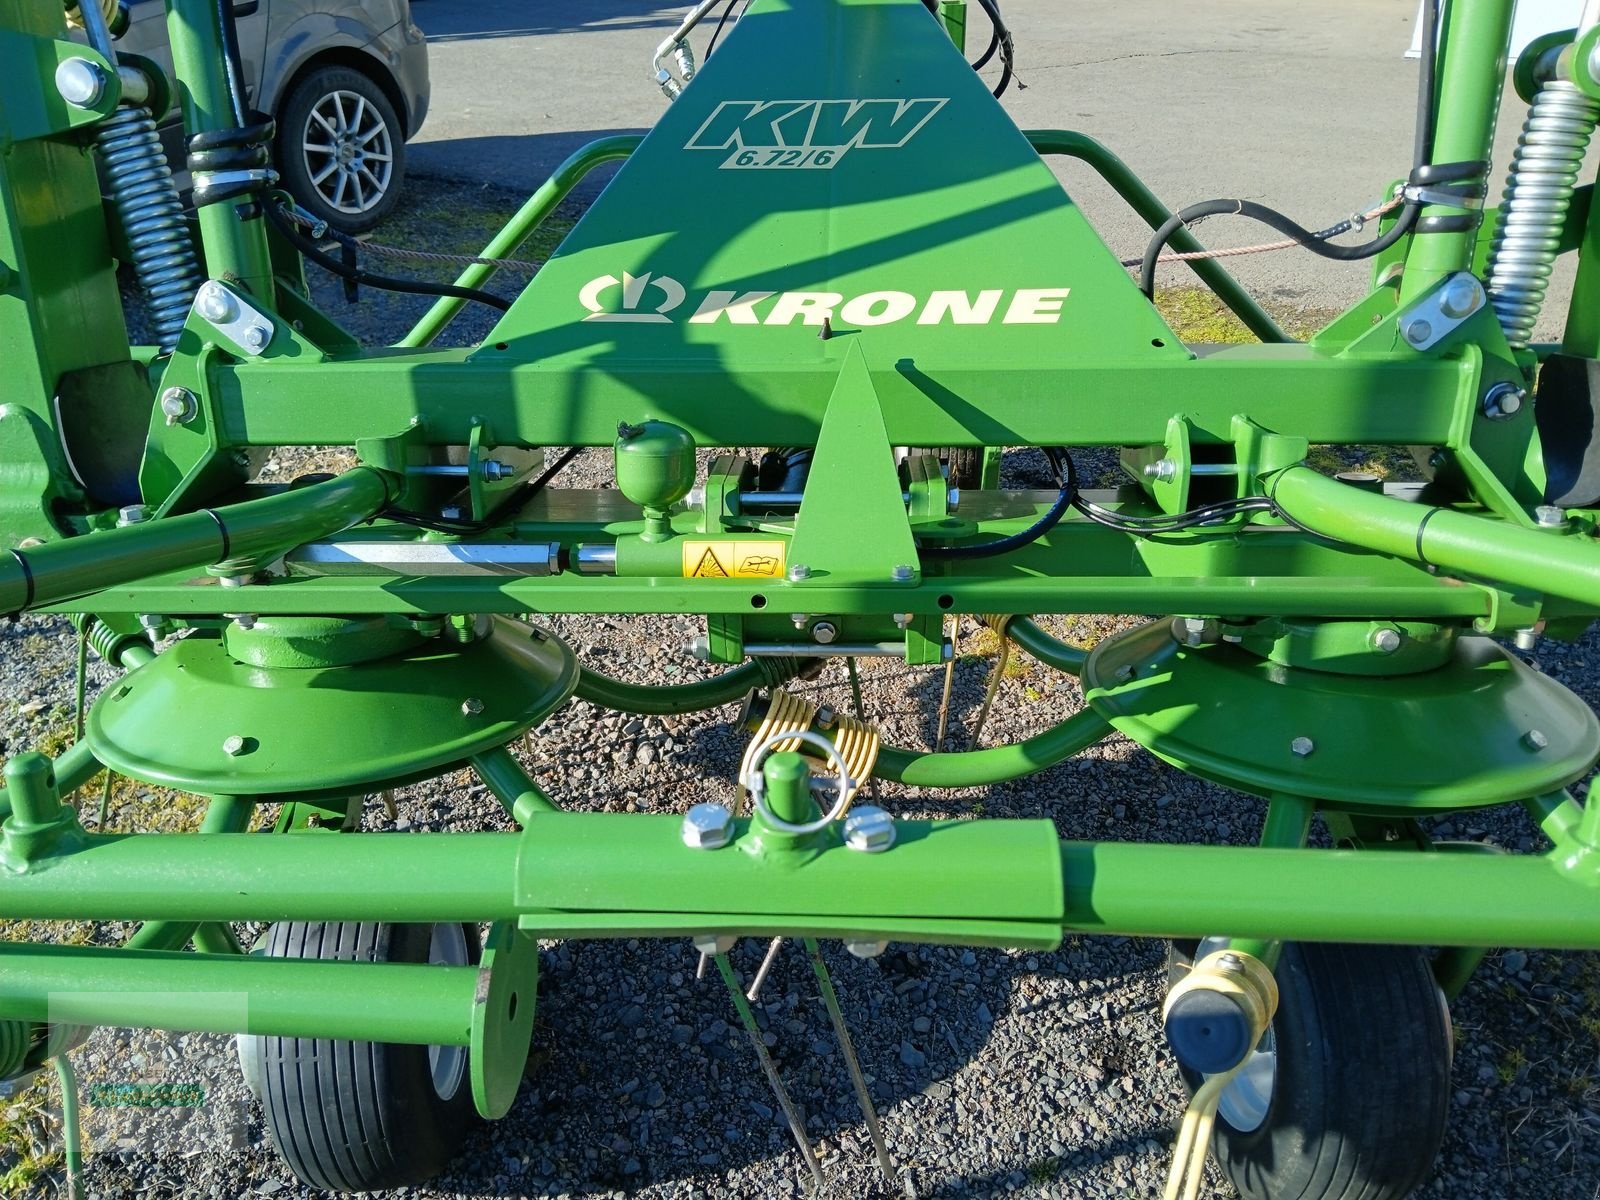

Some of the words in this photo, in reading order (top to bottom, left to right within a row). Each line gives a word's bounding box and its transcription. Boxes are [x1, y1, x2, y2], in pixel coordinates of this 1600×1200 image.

[683, 98, 950, 149] KW
[735, 150, 835, 167] 6.72/6
[688, 288, 1071, 325] KRONE
